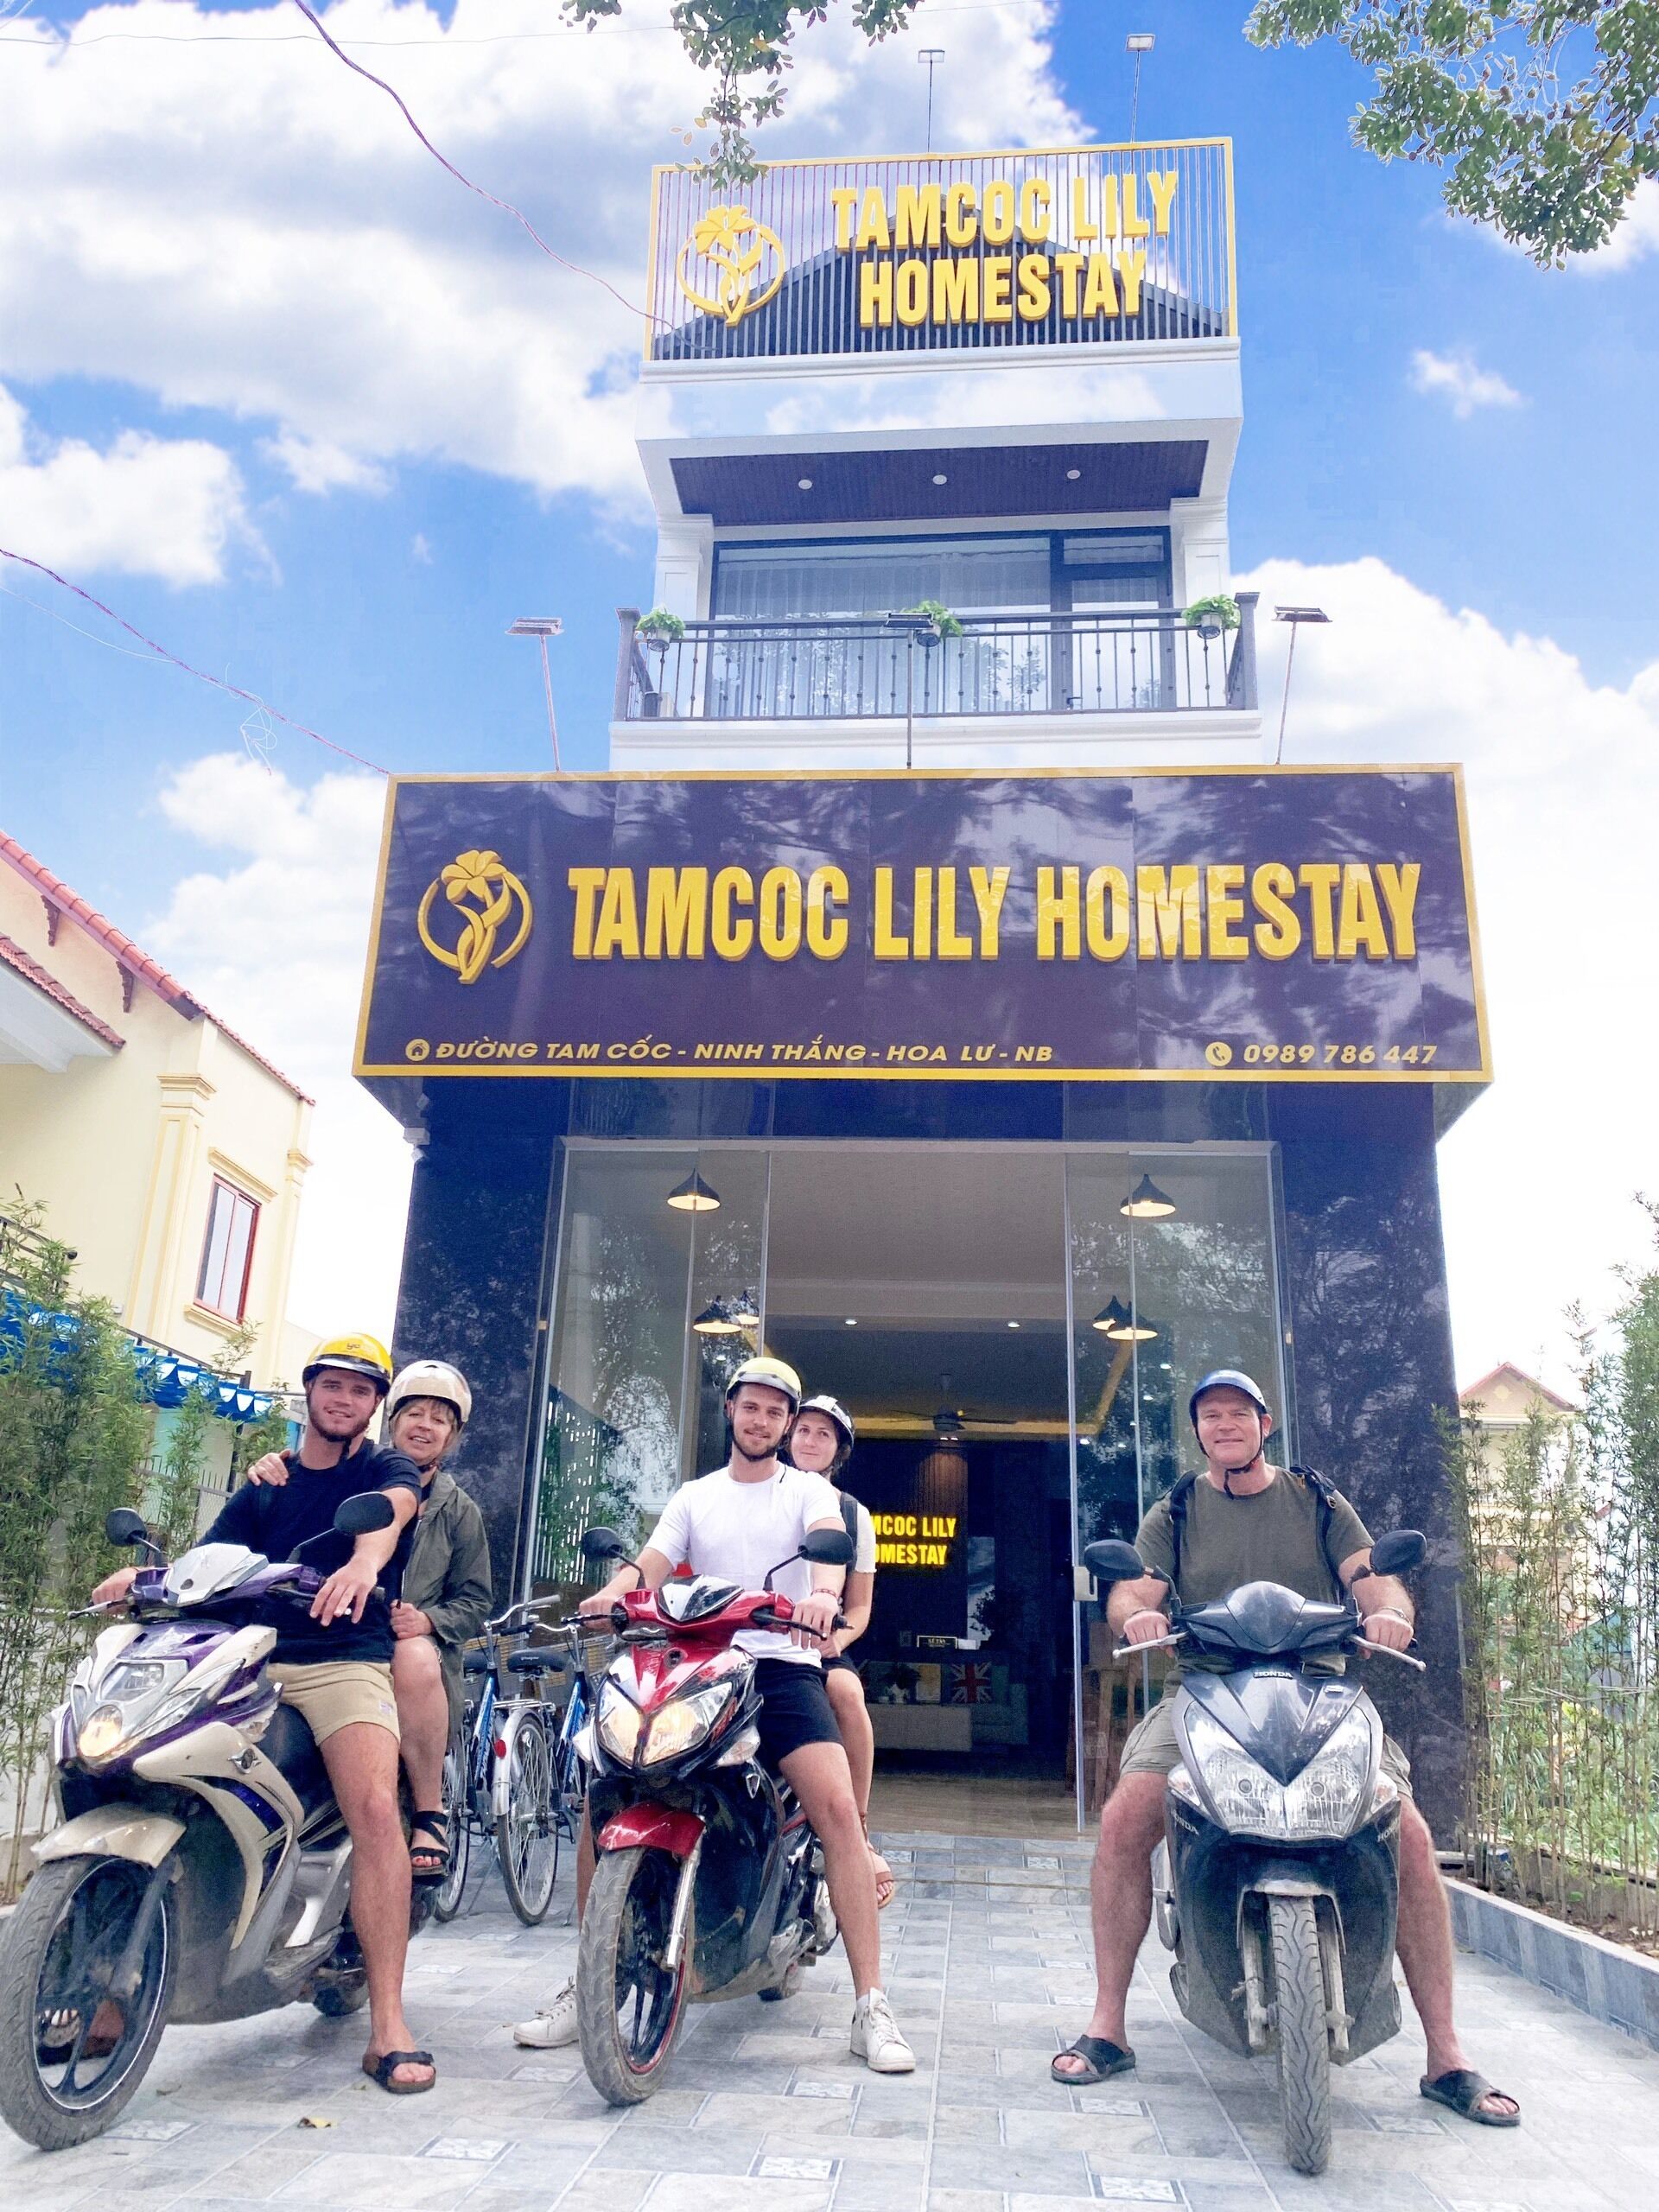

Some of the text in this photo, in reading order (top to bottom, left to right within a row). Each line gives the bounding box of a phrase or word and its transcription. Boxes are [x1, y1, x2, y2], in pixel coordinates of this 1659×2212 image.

[832, 169, 1179, 253] TAMCOC LILY
[860, 249, 1147, 327] HOMESTAY
[567, 862, 1421, 962] TAMCOC LILY HOMESTAY
[435, 1036, 538, 1059] ĐƯỜNG
[546, 1042, 601, 1059] TAM
[607, 1033, 672, 1060] CỐC
[693, 1042, 764, 1060] NINH
[771, 1034, 867, 1061] THẮNG
[886, 1044, 948, 1061] HOA
[960, 1043, 997, 1062] LƯ
[1014, 1045, 1053, 1063] NB
[1243, 1044, 1439, 1064] 0989 786 447
[870, 1515, 957, 1538] MCOC LILY
[875, 1543, 948, 1565] MESTAY
[1254, 1670, 1294, 1679] HONDA
